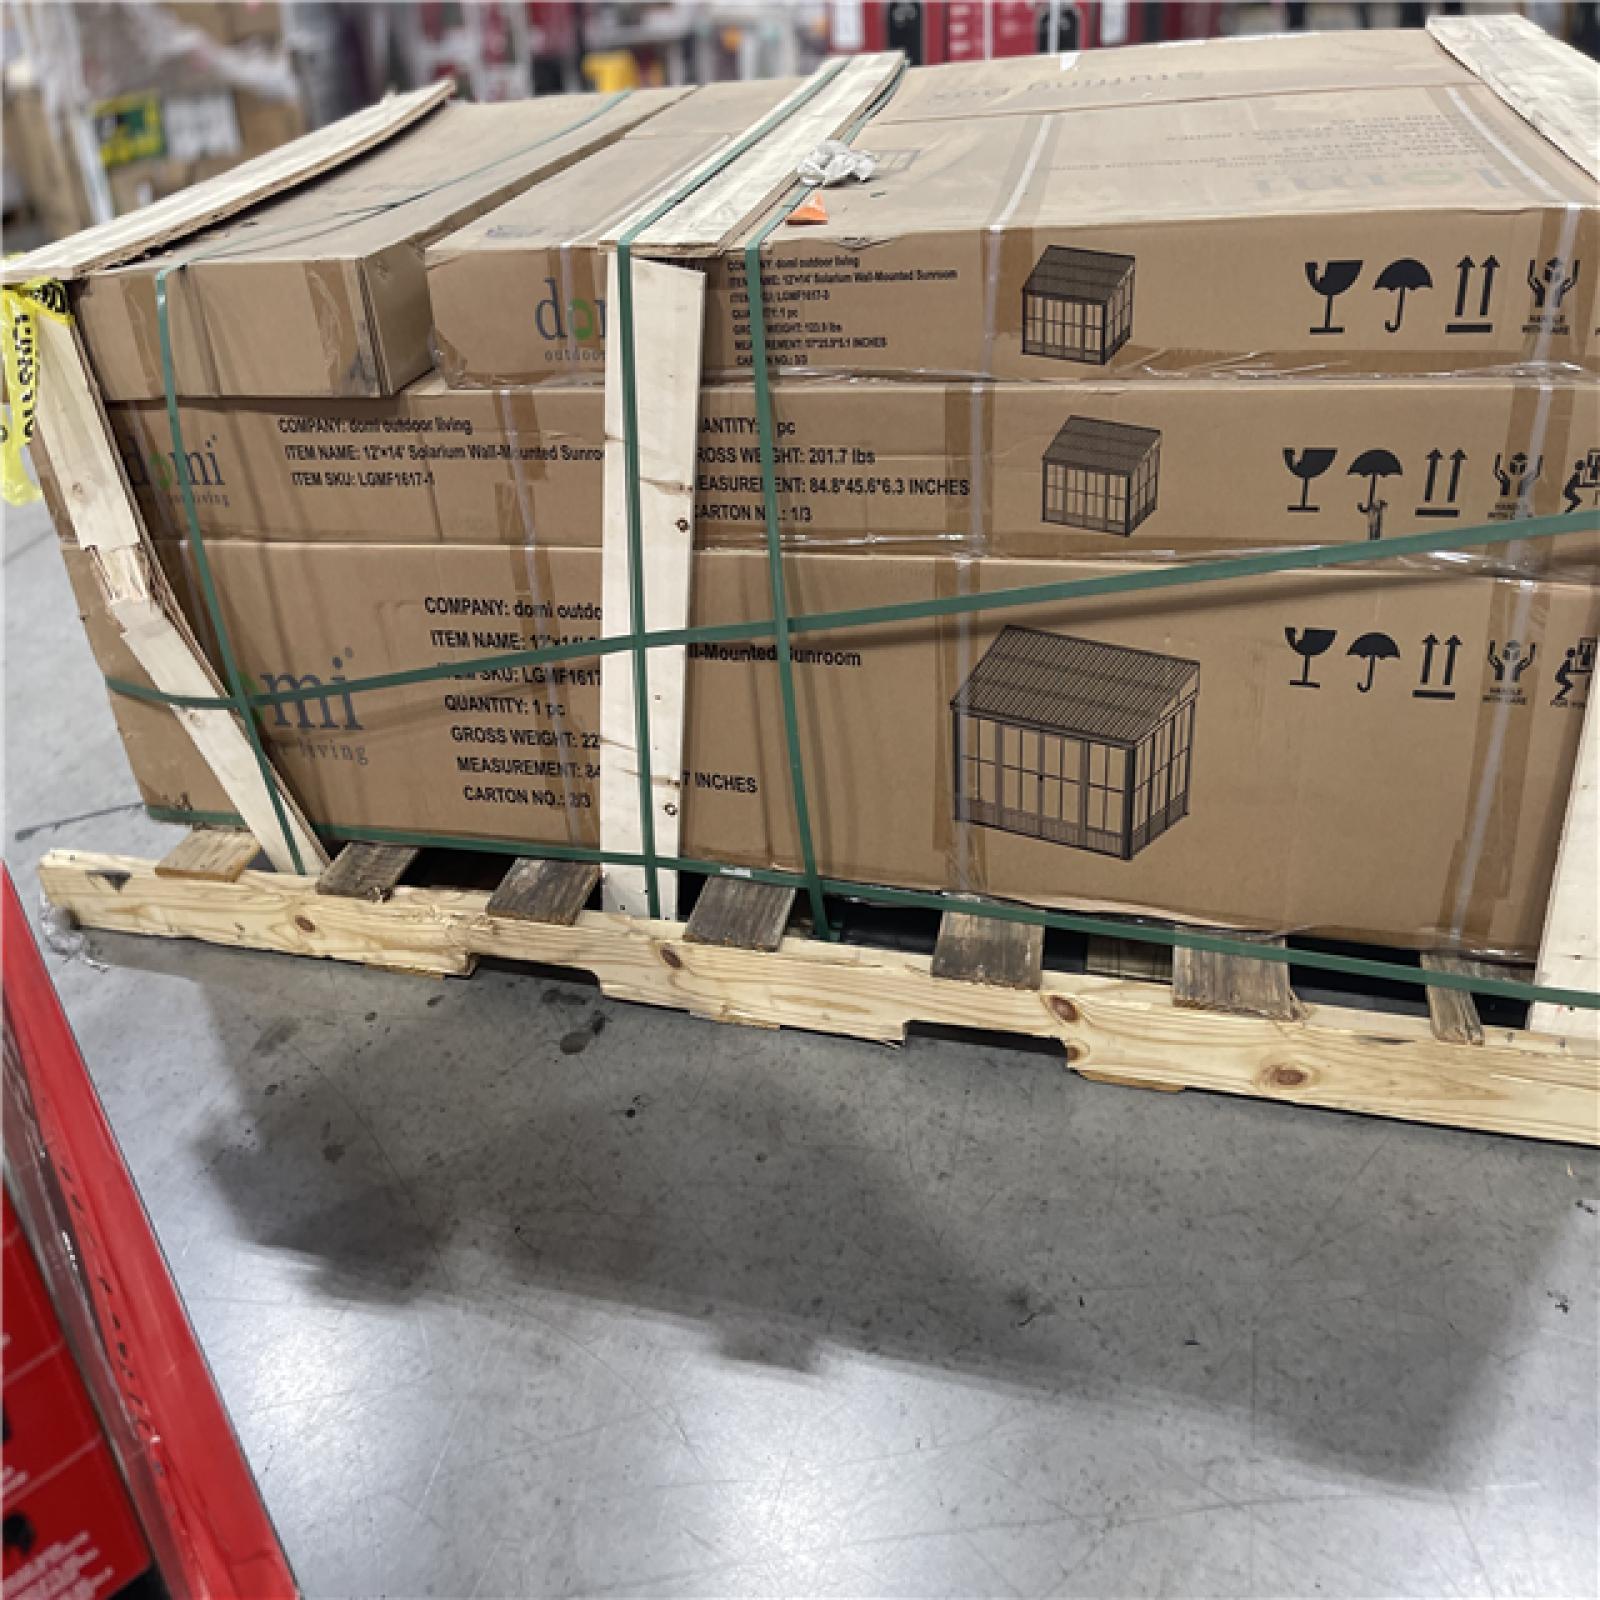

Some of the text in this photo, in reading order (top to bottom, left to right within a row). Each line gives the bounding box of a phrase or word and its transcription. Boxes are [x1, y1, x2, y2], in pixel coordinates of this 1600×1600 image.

[535, 277, 606, 340] do
[279, 416, 348, 433] COMPANY:
[435, 416, 473, 435] living
[701, 417, 795, 437] ANTITY: pc
[285, 444, 317, 460] ITEM
[318, 444, 361, 460] NAME:
[408, 444, 465, 460] Solarium
[467, 444, 558, 460] Wall-Mounted
[560, 444, 604, 460] Sunro
[697, 447, 876, 465] ROSS WEGHT: 201.7 lbs
[291, 471, 322, 486] ITEM
[325, 471, 354, 486] SKU:
[699, 474, 806, 494] EASUREENT:
[909, 479, 971, 496] INCHES
[790, 506, 812, 522] 1/3
[424, 596, 603, 620] COMPANY: domi outdo
[430, 629, 470, 648] ITEM
[473, 631, 525, 651] NAME:
[688, 643, 778, 662] ll-Mounted
[789, 648, 861, 667] unroom
[444, 694, 528, 716] QUANTITY:
[532, 699, 541, 716] 1
[451, 725, 601, 749] GROSS WEIGHT: 22
[457, 756, 583, 778] MEASUREMENT:
[694, 772, 759, 793] INCHES
[463, 784, 528, 804] CARTON
[532, 789, 566, 807] NO.:
